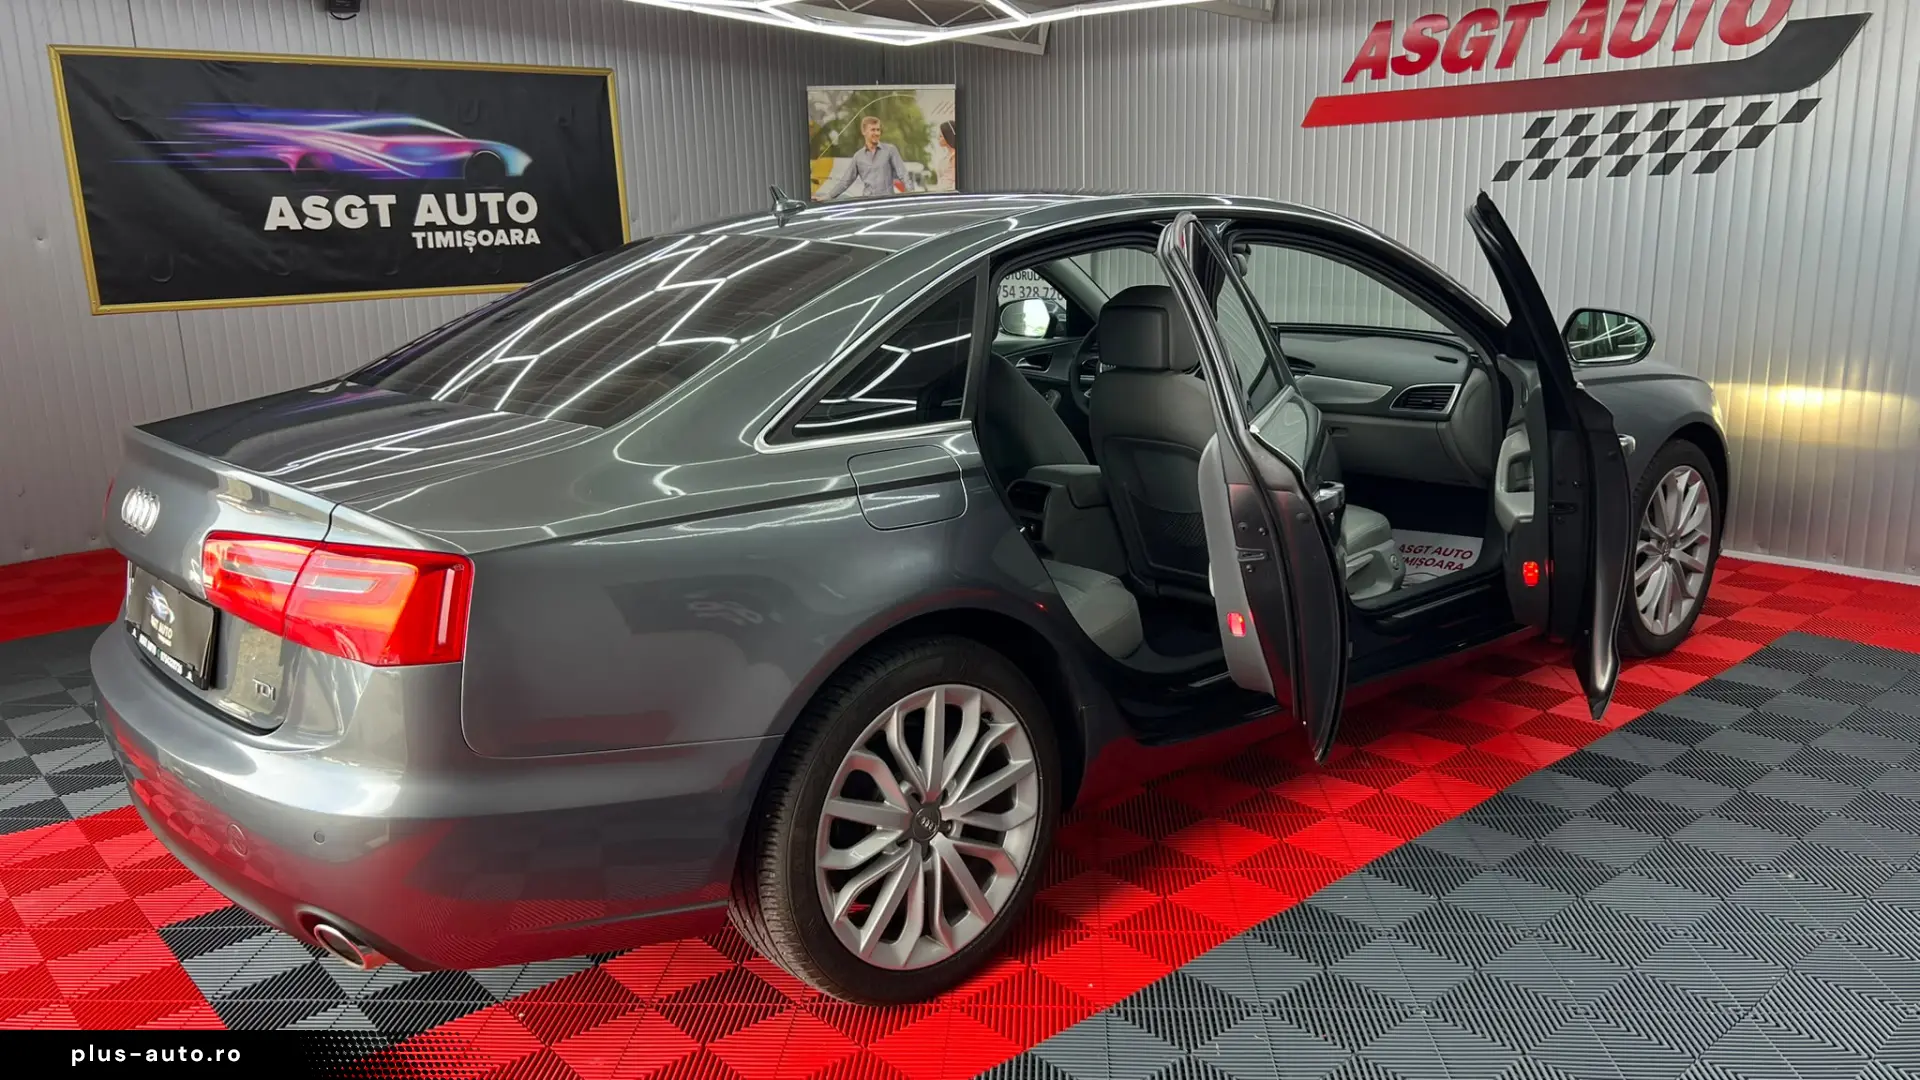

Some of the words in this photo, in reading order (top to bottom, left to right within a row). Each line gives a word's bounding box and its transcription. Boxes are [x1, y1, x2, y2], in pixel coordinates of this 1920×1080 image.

[1342, 0, 1549, 83] ASGT
[1543, 0, 1790, 64] AUTO
[264, 194, 397, 231] ASGT
[413, 191, 539, 227] AUTO
[411, 228, 541, 253] TIMIȘOARA
[1399, 543, 1432, 555] ASGT
[1431, 546, 1474, 560] AUTO
[1402, 556, 1465, 571] MIȘOARA
[252, 678, 276, 701] TDI
